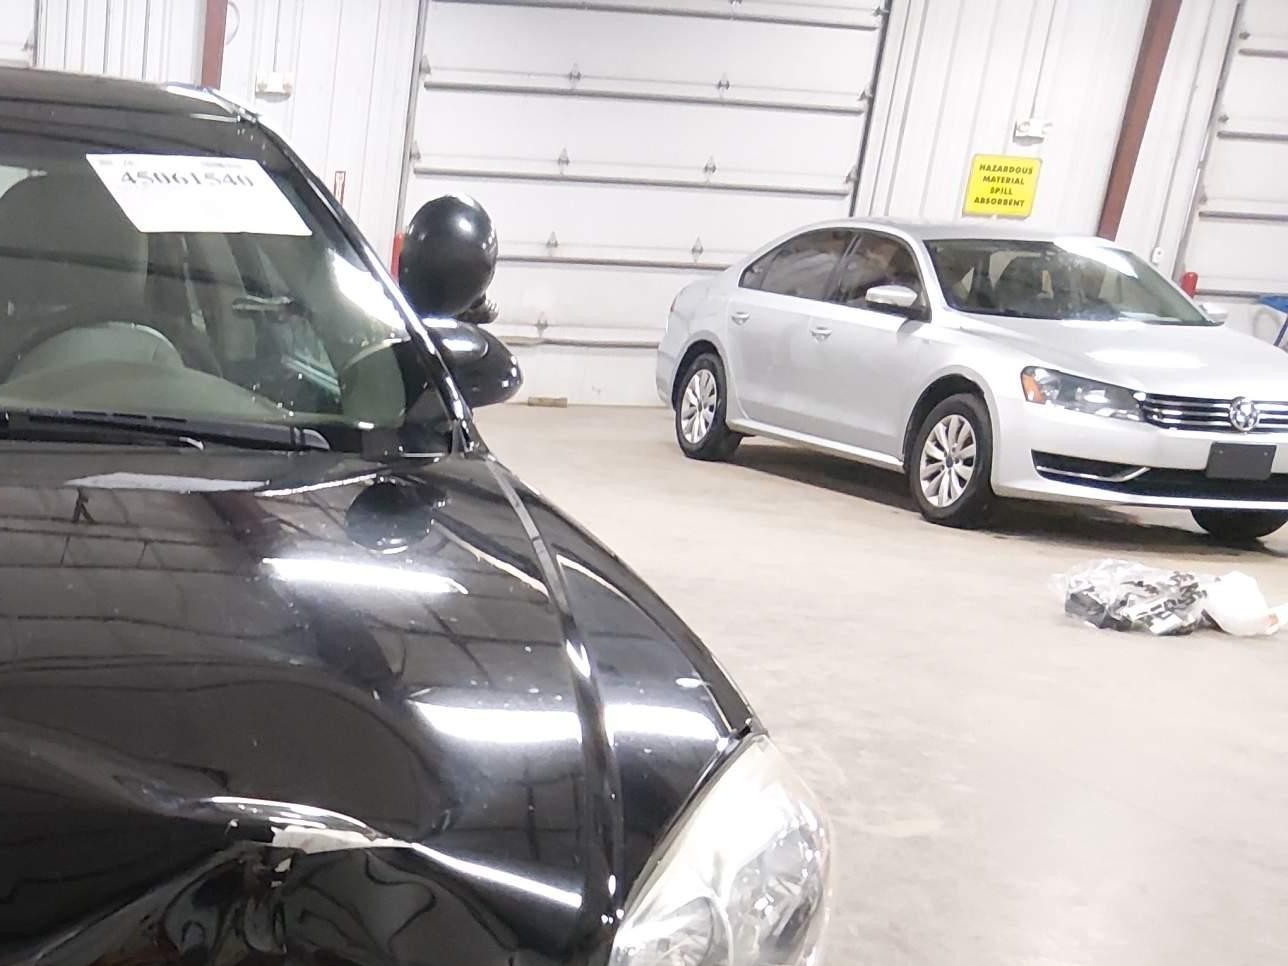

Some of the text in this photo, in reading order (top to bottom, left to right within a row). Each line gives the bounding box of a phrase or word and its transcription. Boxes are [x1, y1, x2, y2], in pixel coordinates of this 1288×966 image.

[979, 164, 1033, 174] HAZARDOUS
[982, 175, 1024, 185] MATERIAL
[989, 186, 1013, 195] SPILL
[974, 197, 1024, 207] ABSORBENT
